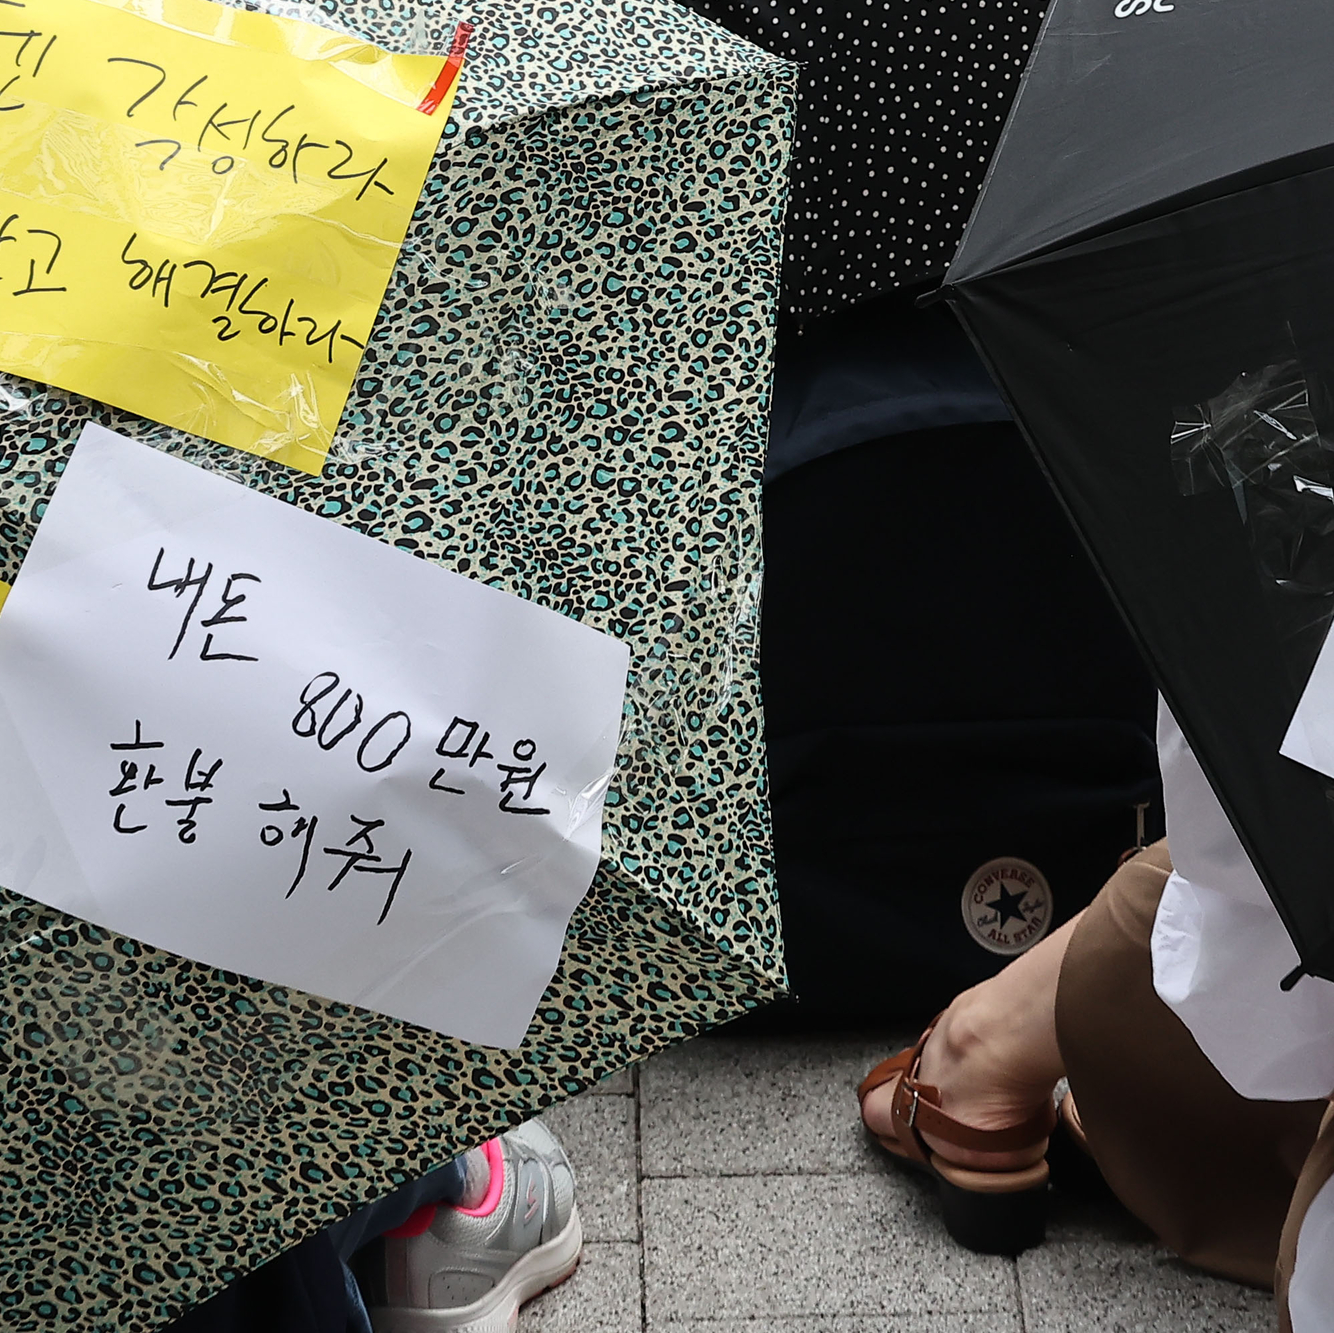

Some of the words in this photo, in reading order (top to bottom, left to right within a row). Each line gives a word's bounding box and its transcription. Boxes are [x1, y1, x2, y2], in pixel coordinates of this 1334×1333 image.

[107, 56, 396, 200] 각성하라
[121, 232, 366, 364] 해결하라
[973, 868, 1036, 905] CONVERSE
[987, 927, 1011, 945] ALL
[1012, 915, 1043, 944] STAR
